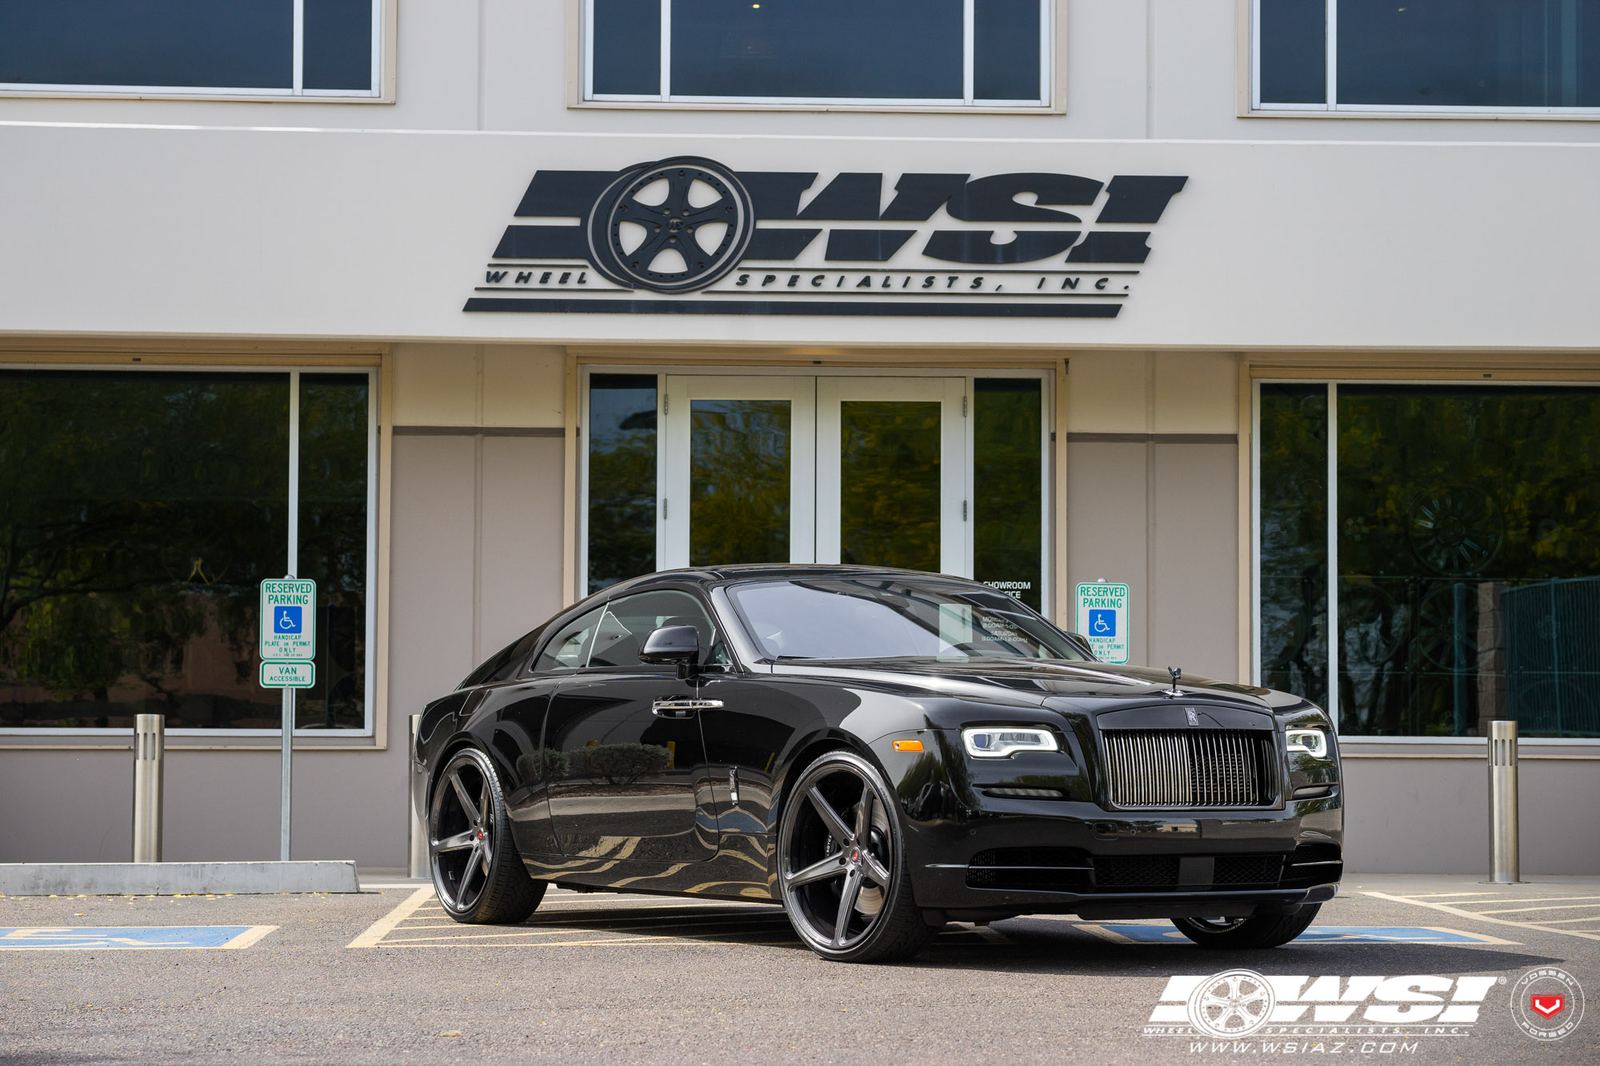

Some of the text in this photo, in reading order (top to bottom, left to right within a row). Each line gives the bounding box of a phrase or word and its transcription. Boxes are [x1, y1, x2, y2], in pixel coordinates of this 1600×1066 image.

[752, 171, 1189, 264] WSI
[485, 270, 1131, 292] WHEEL SPECIALISTS, INC.
[265, 583, 312, 594] RESERVED
[1080, 586, 1126, 597] RESERVED
[268, 595, 309, 605] PARKING
[1082, 597, 1122, 608] PARKING
[279, 666, 297, 675] VAN
